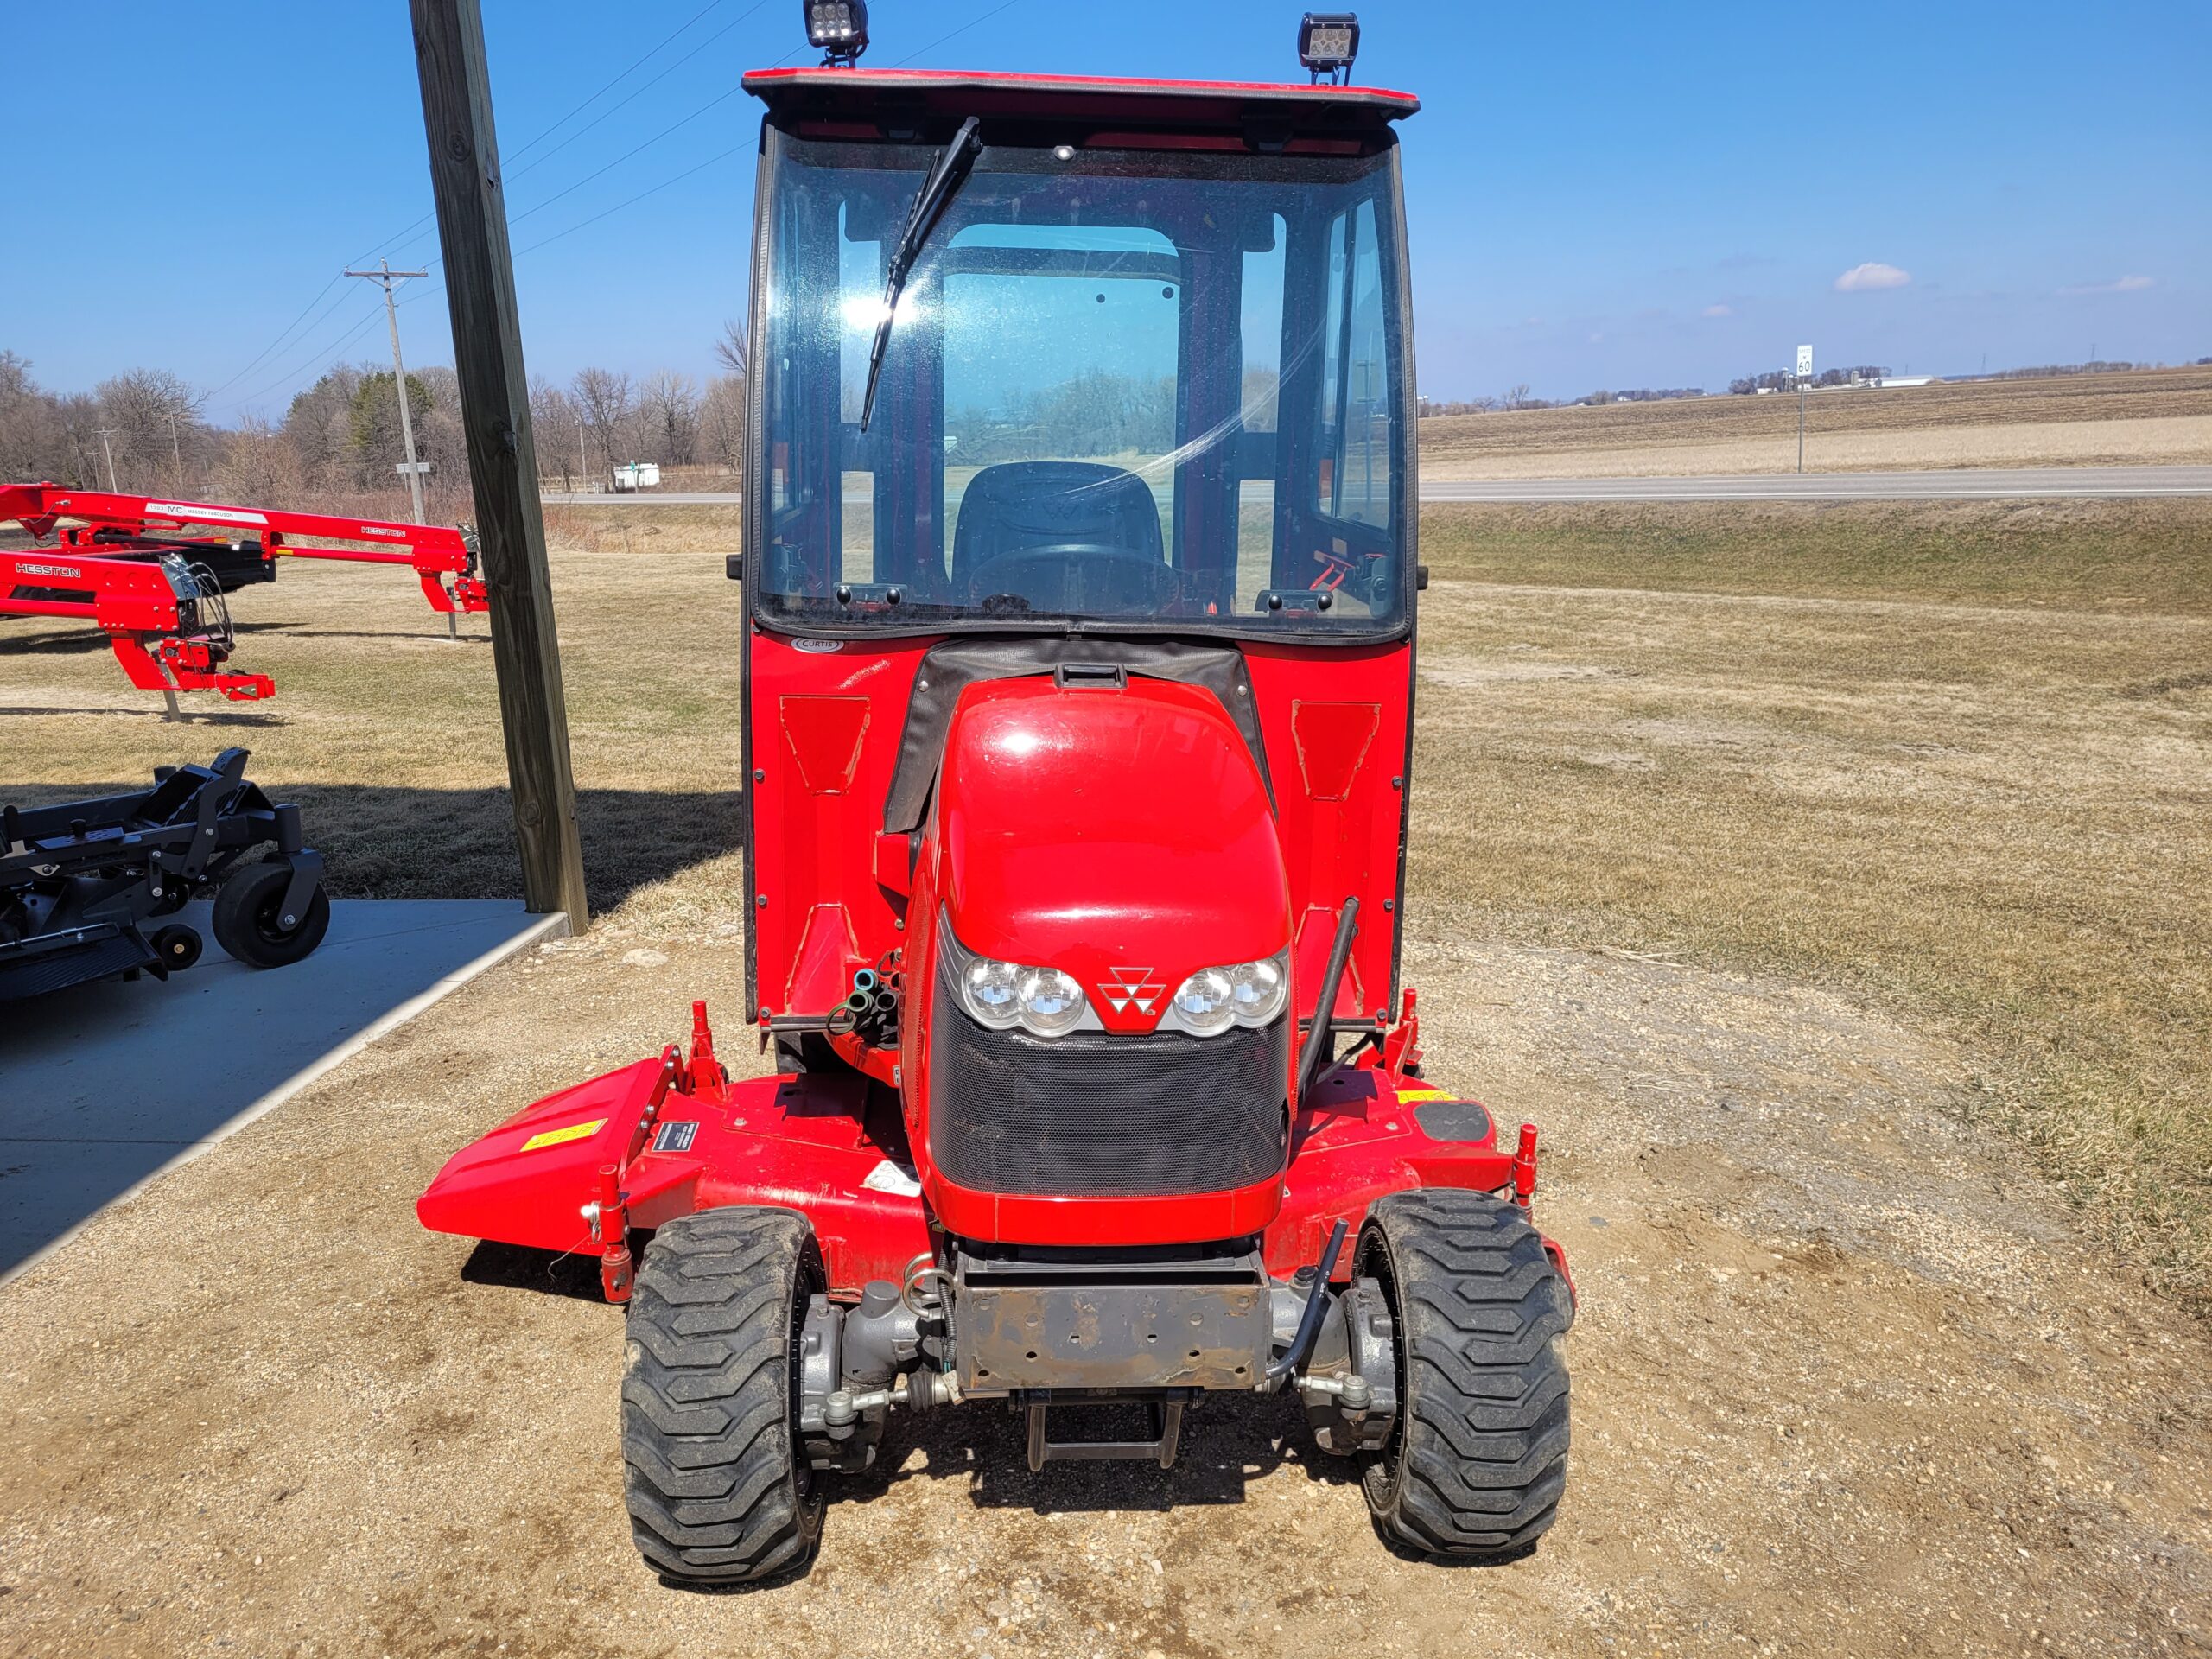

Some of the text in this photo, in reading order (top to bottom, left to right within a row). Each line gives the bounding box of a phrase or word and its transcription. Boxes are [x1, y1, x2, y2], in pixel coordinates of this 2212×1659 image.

[1799, 361, 1810, 372] 60
[361, 526, 406, 537] HESSTON
[16, 563, 81, 578] HESSTON
